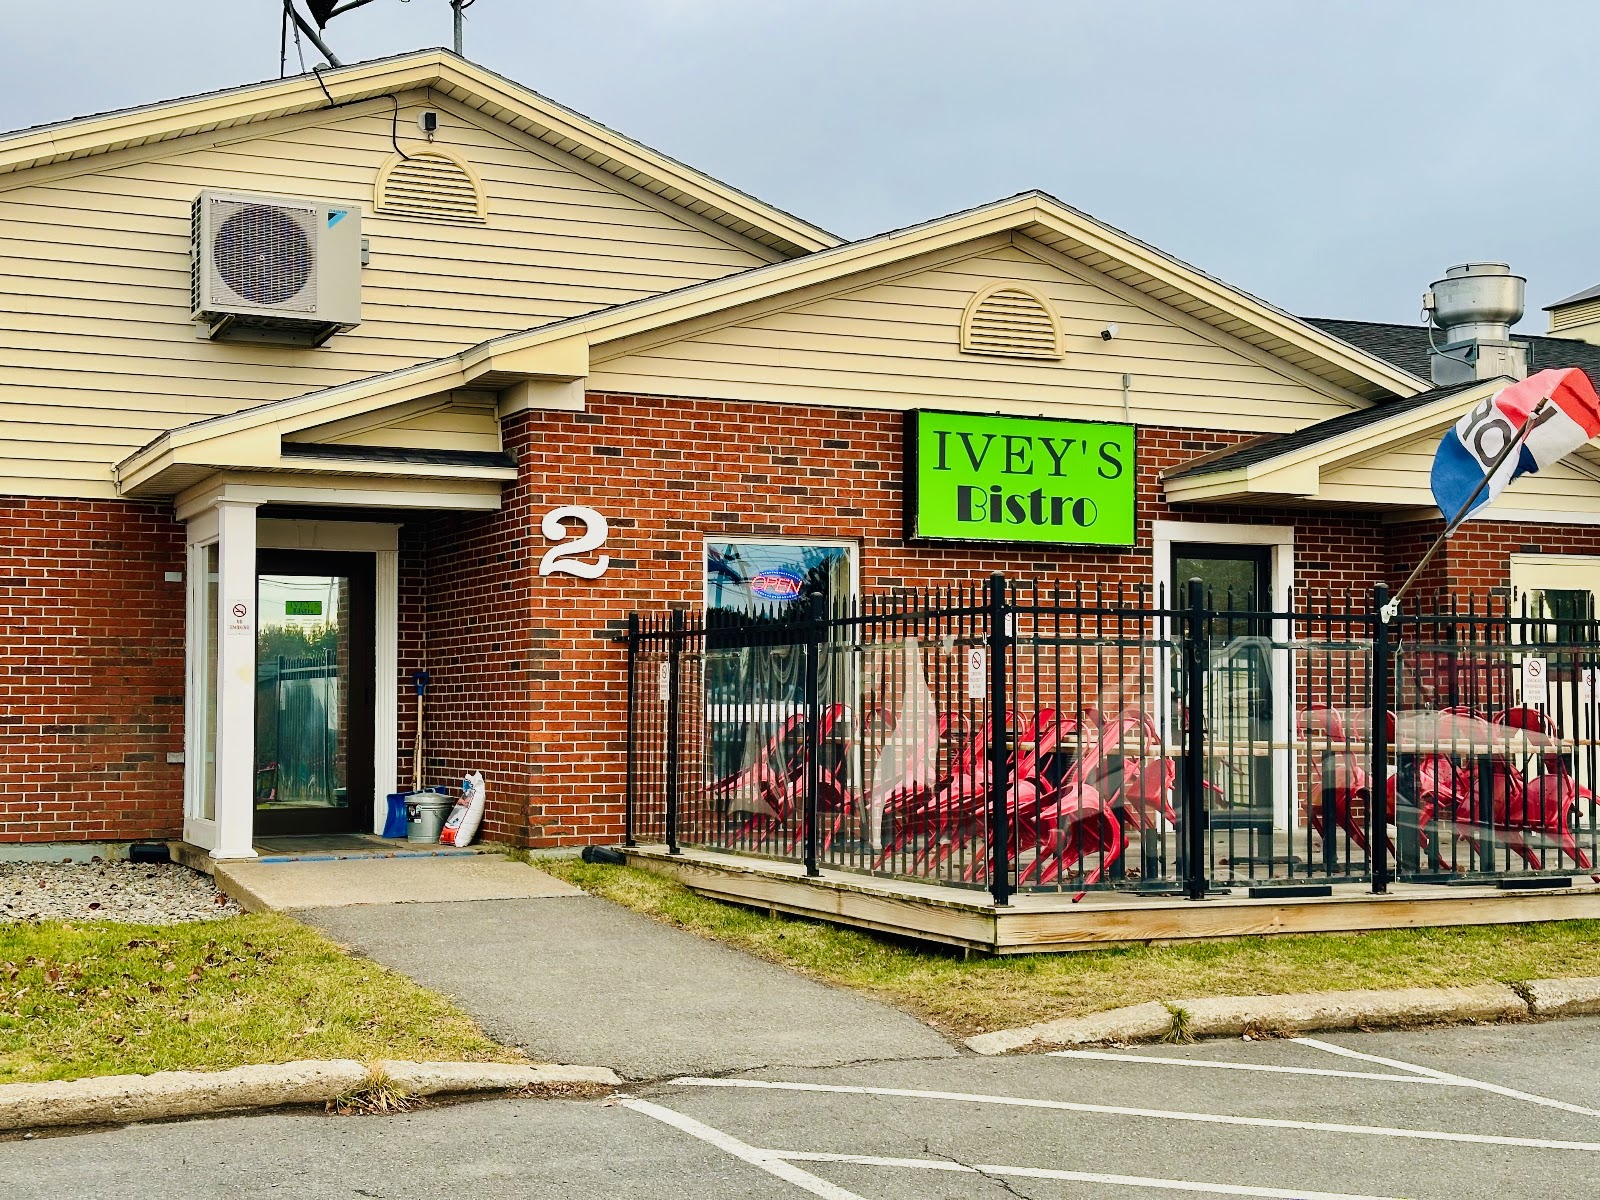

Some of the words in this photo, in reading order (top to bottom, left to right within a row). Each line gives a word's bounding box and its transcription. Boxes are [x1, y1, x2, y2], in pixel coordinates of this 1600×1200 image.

[932, 430, 1123, 480] IVEY'S
[957, 484, 1098, 528] Bistro
[538, 506, 610, 579] 2
[751, 576, 803, 596] OPEN
